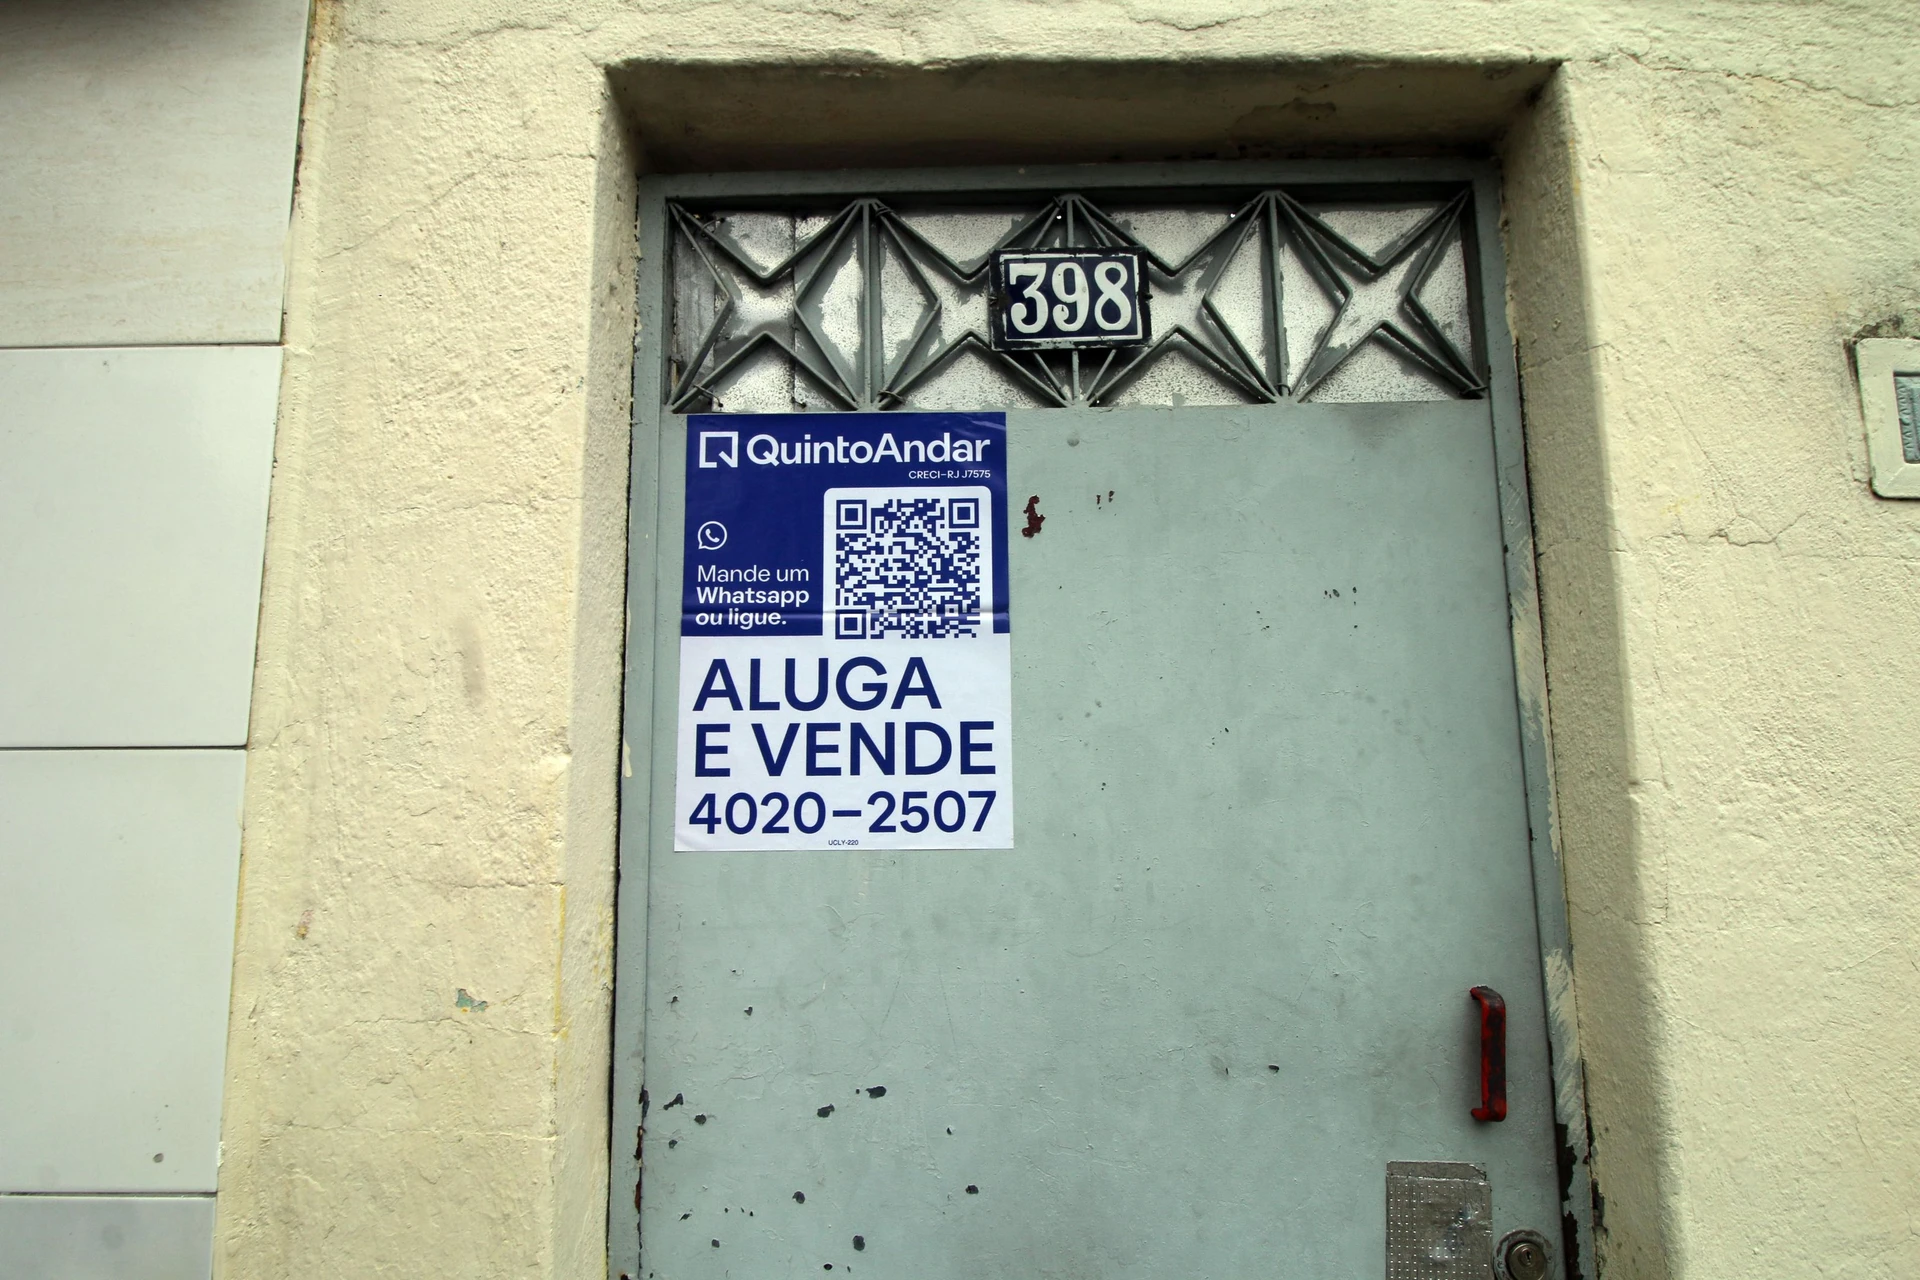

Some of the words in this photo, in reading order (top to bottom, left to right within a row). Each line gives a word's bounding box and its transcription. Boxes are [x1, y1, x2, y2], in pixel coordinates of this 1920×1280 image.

[1009, 262, 1132, 333] 398
[747, 432, 990, 467] QuintoAndar
[908, 470, 959, 480] CRECI-RJ
[961, 469, 990, 479] J7575
[697, 565, 770, 583] Mande
[777, 567, 809, 582] um
[696, 586, 809, 607] Whatsapp
[695, 612, 722, 626] ou
[728, 608, 787, 629] ligue.
[692, 656, 942, 711] ALUGA
[695, 723, 730, 777] E
[751, 721, 996, 777] VENDE
[689, 790, 996, 834] 4020-2507
